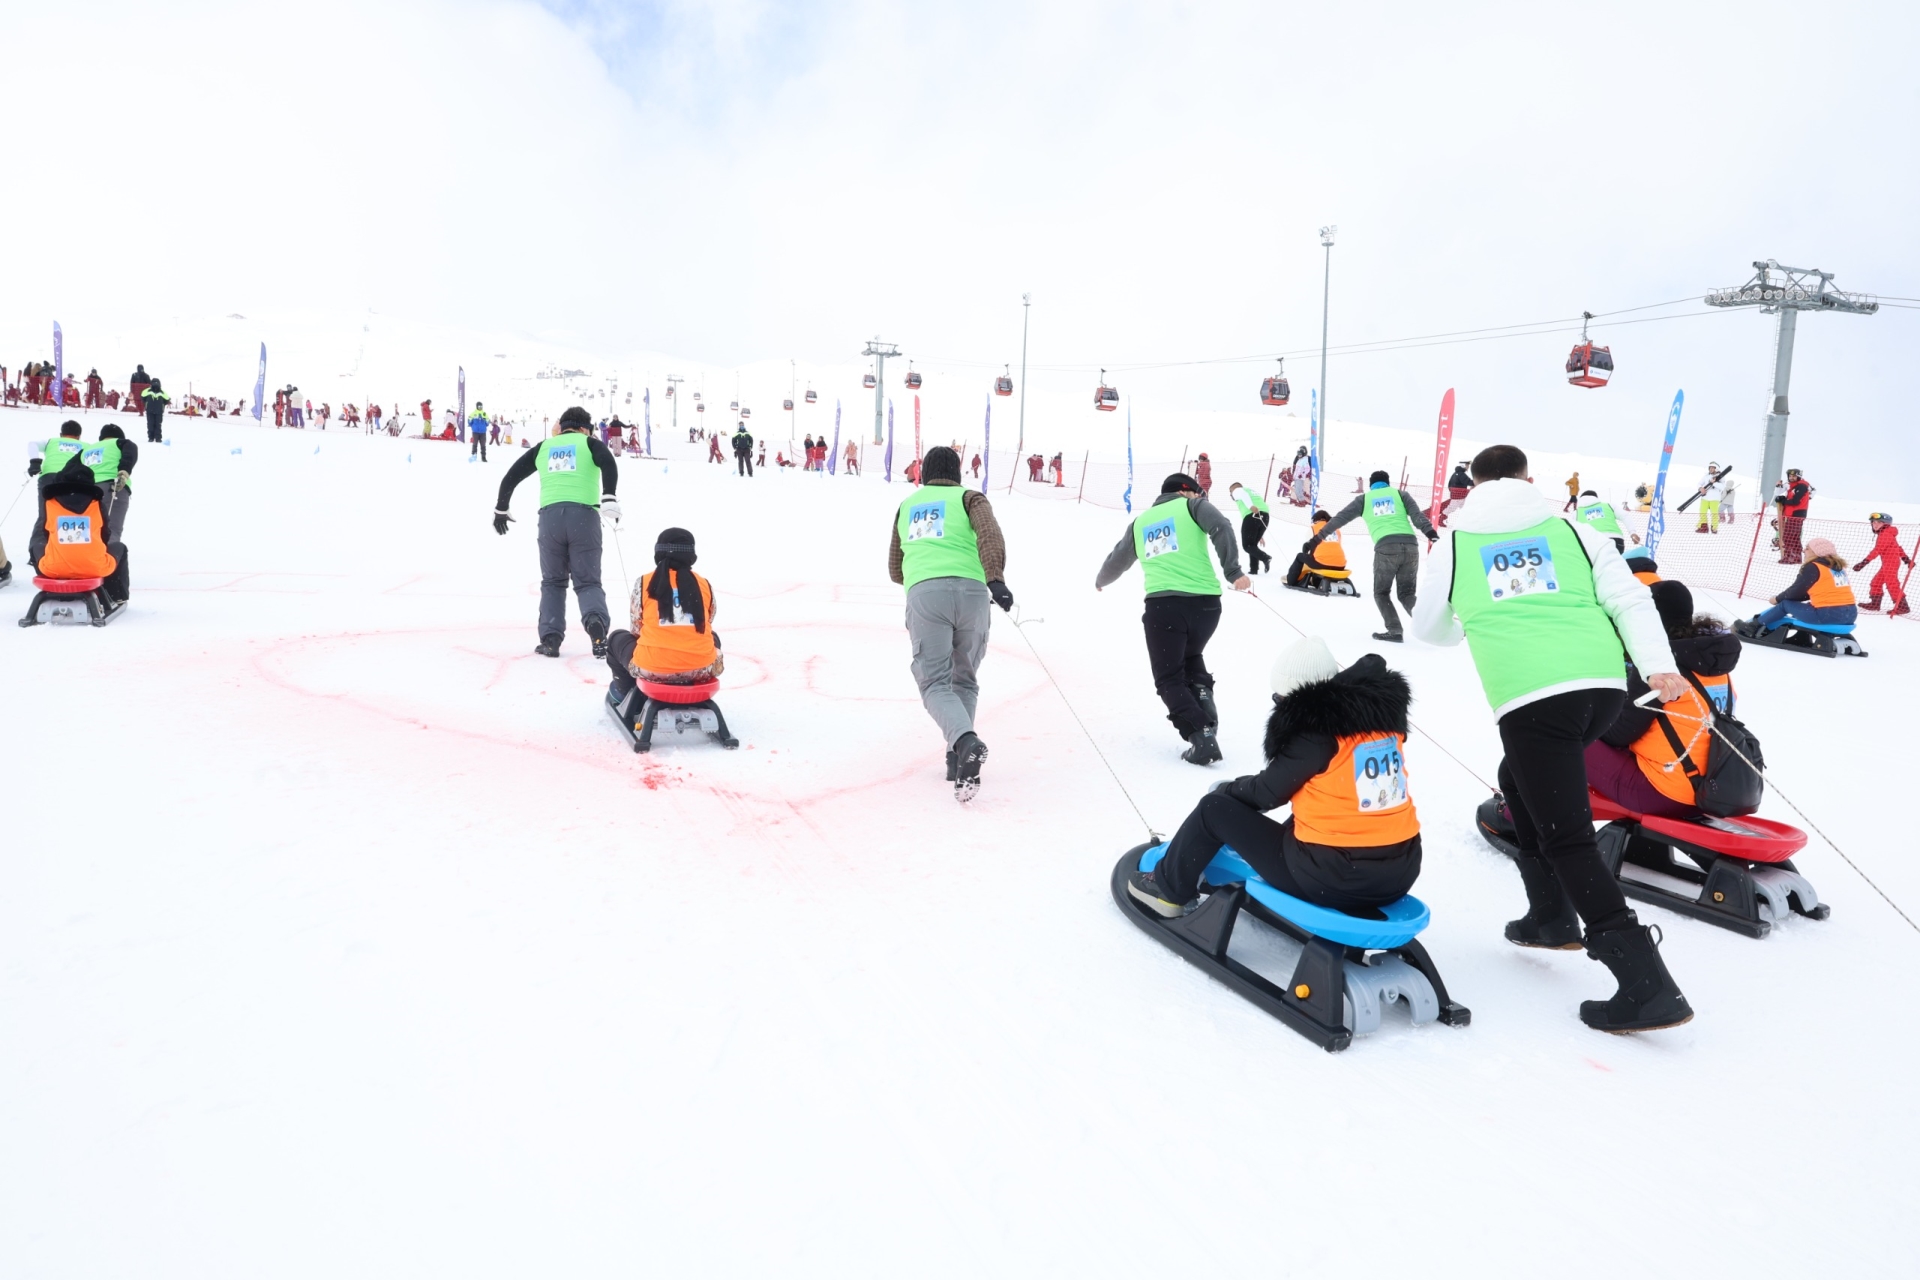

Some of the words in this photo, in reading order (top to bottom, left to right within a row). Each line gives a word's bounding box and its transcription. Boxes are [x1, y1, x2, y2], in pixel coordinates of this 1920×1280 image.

[552, 450, 572, 460] 004
[1375, 500, 1390, 508] 017
[913, 508, 940, 524] 015
[62, 521, 86, 531] 014
[1147, 525, 1171, 543] 020
[1493, 547, 1543, 572] 035
[1364, 750, 1400, 780] 015
